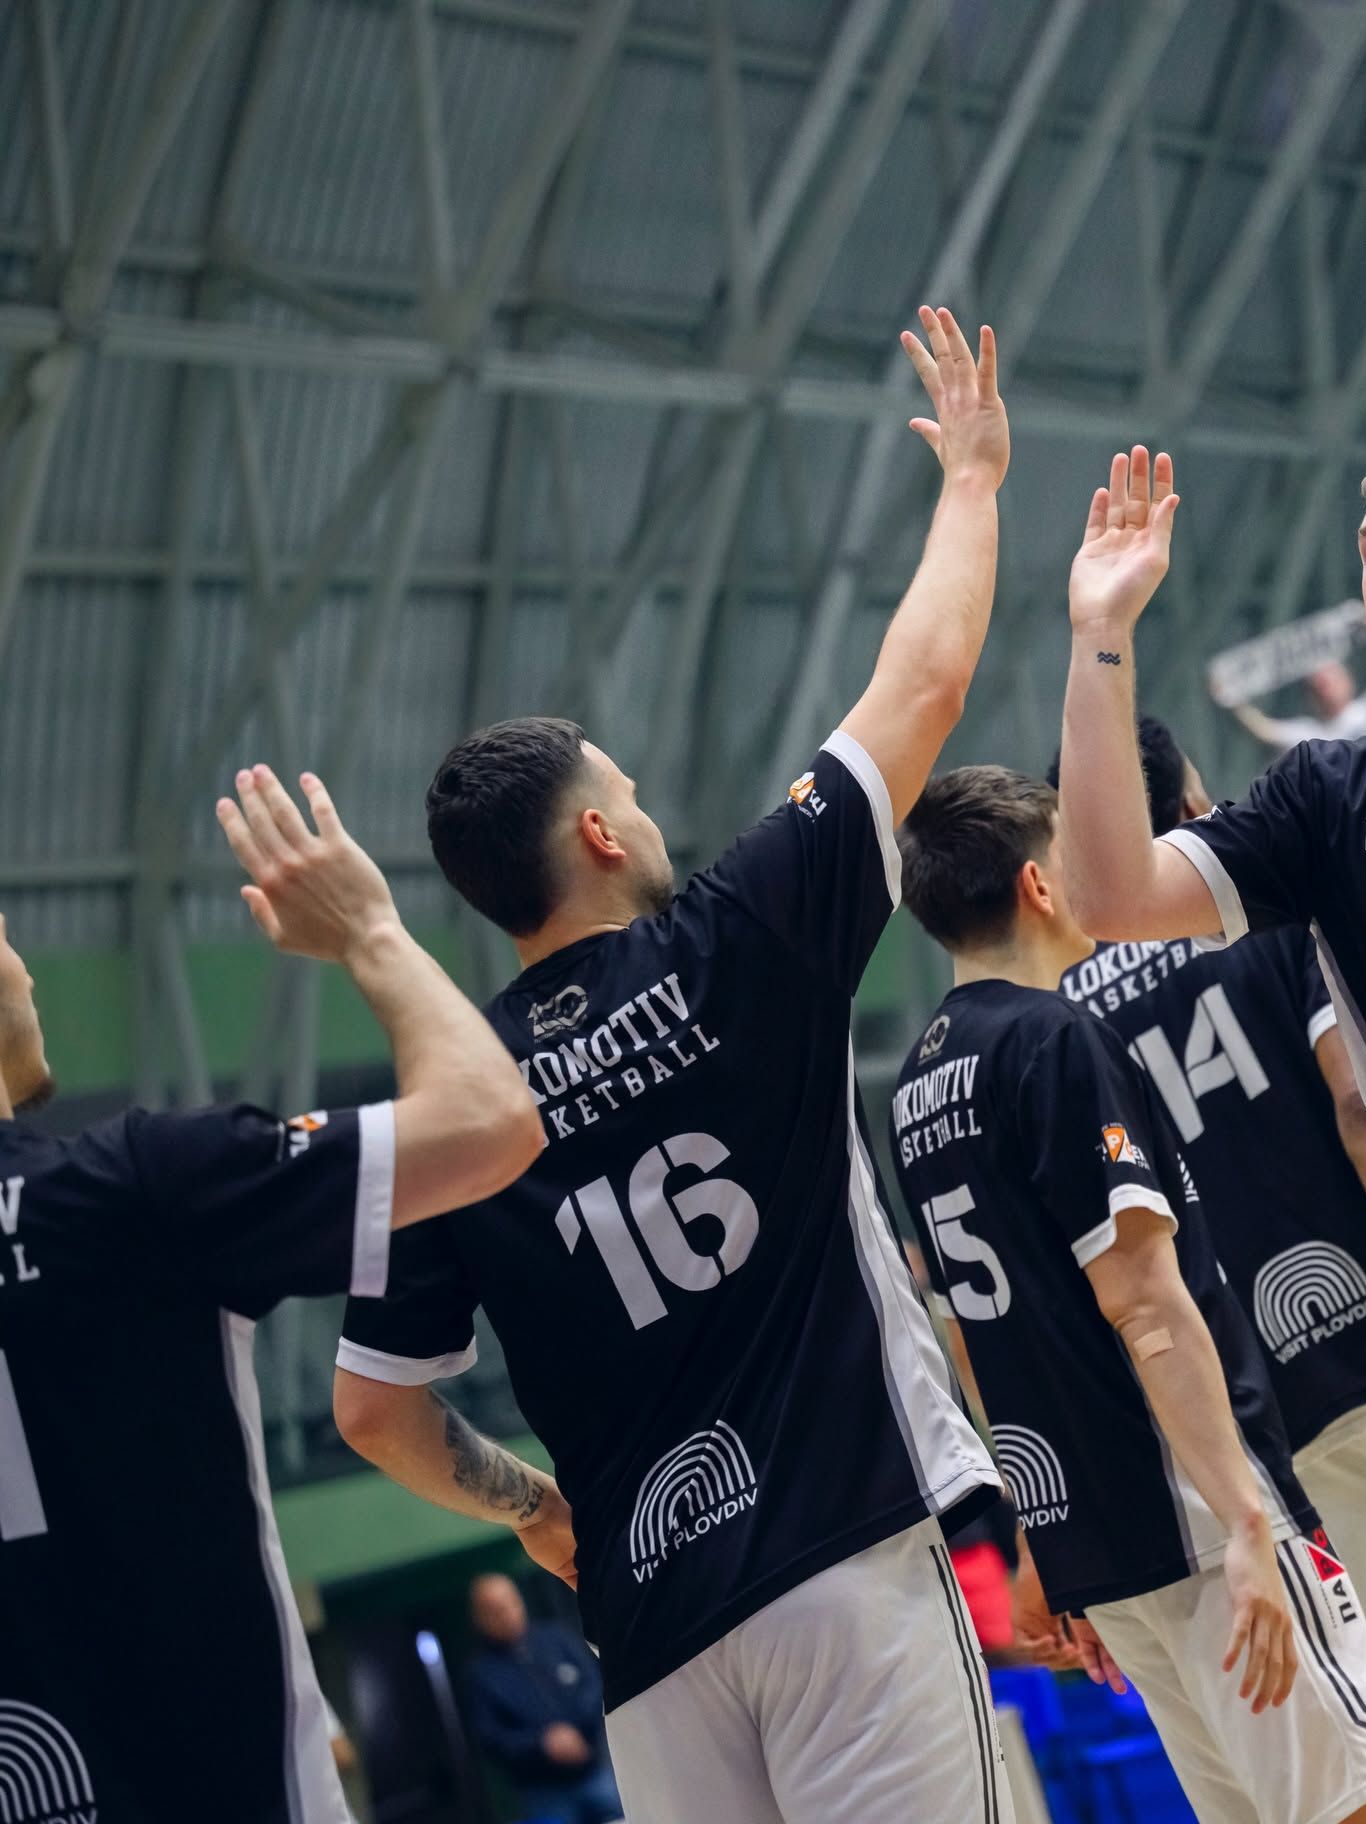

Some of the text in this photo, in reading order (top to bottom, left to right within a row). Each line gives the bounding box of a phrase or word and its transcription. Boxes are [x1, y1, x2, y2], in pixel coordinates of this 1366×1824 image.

[1062, 939, 1171, 1002] LOKOM
[541, 1023, 721, 1149] KETBALL
[1129, 983, 1270, 1145] 14
[554, 1132, 760, 1331] 16
[673, 1487, 758, 1550] PLOVDIV
